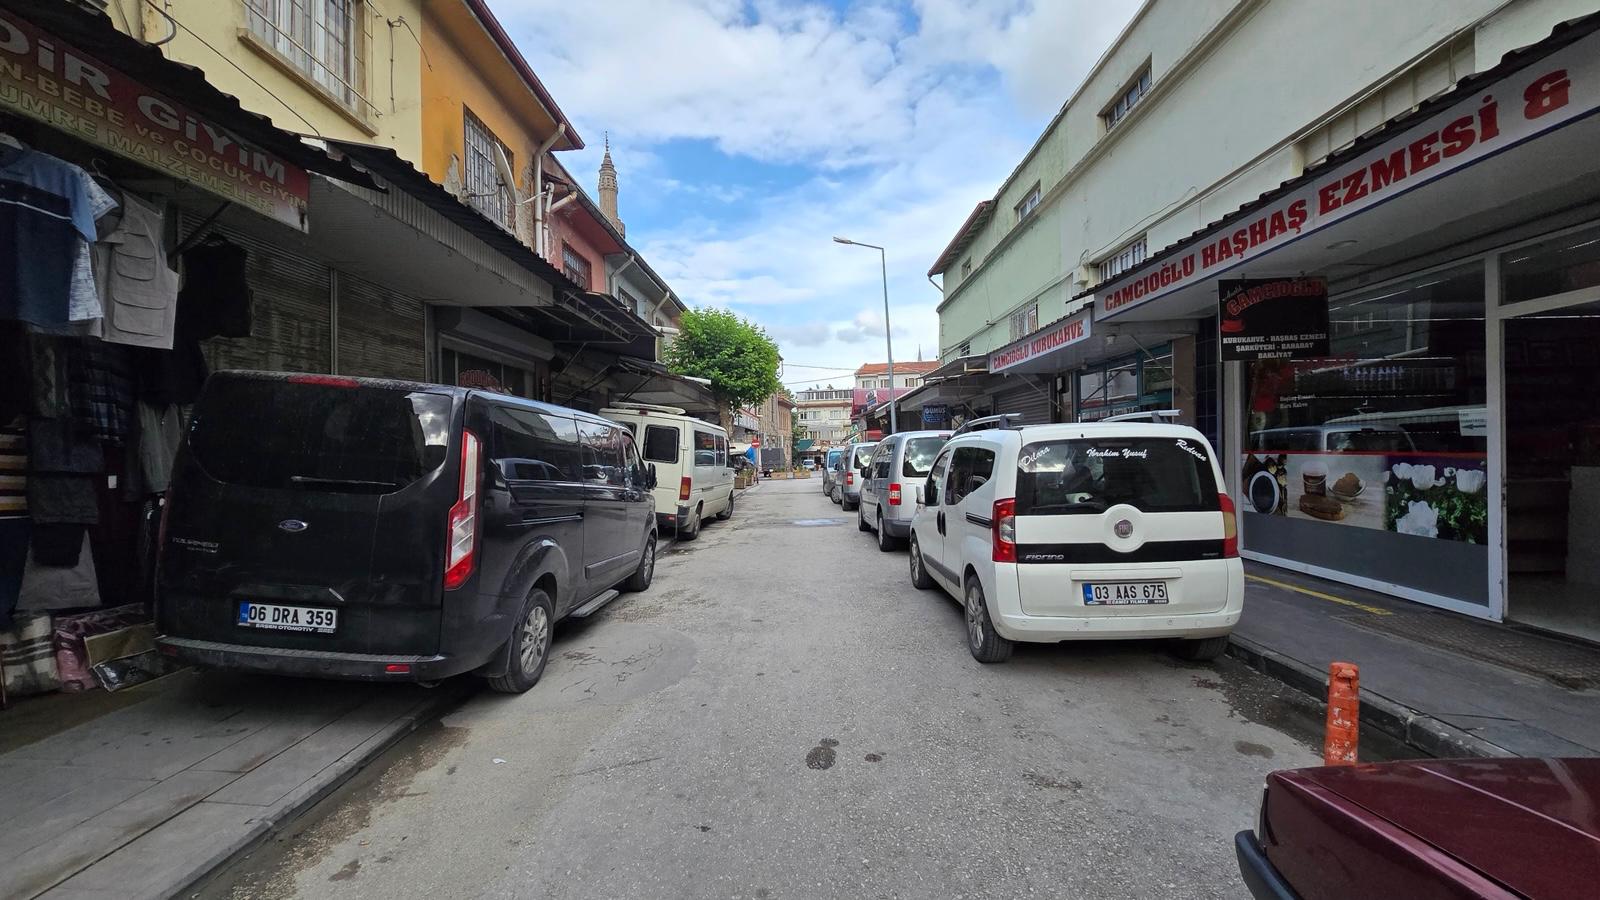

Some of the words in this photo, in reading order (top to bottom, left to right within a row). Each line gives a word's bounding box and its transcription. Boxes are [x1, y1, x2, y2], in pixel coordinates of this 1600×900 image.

[136, 124, 164, 146] ve
[173, 139, 253, 188] ÇOCUK
[1104, 255, 1196, 313] CAMCIOĞLU
[1201, 198, 1309, 271] HAŞHAŞ
[1318, 95, 1500, 217] EZMESİ
[1522, 68, 1572, 121] &
[993, 342, 1030, 370] CAMCIOĞLU
[1031, 319, 1084, 356] KURUKAHVE
[1222, 335, 1265, 344] KURUKAHVE
[1122, 448, 1148, 459] Yusuf
[1095, 586, 1109, 599] 03
[1116, 585, 1137, 599] AAS
[1143, 584, 1165, 598] 675
[249, 605, 266, 622] 06
[272, 607, 299, 624] DRA
[306, 610, 334, 626] 359
